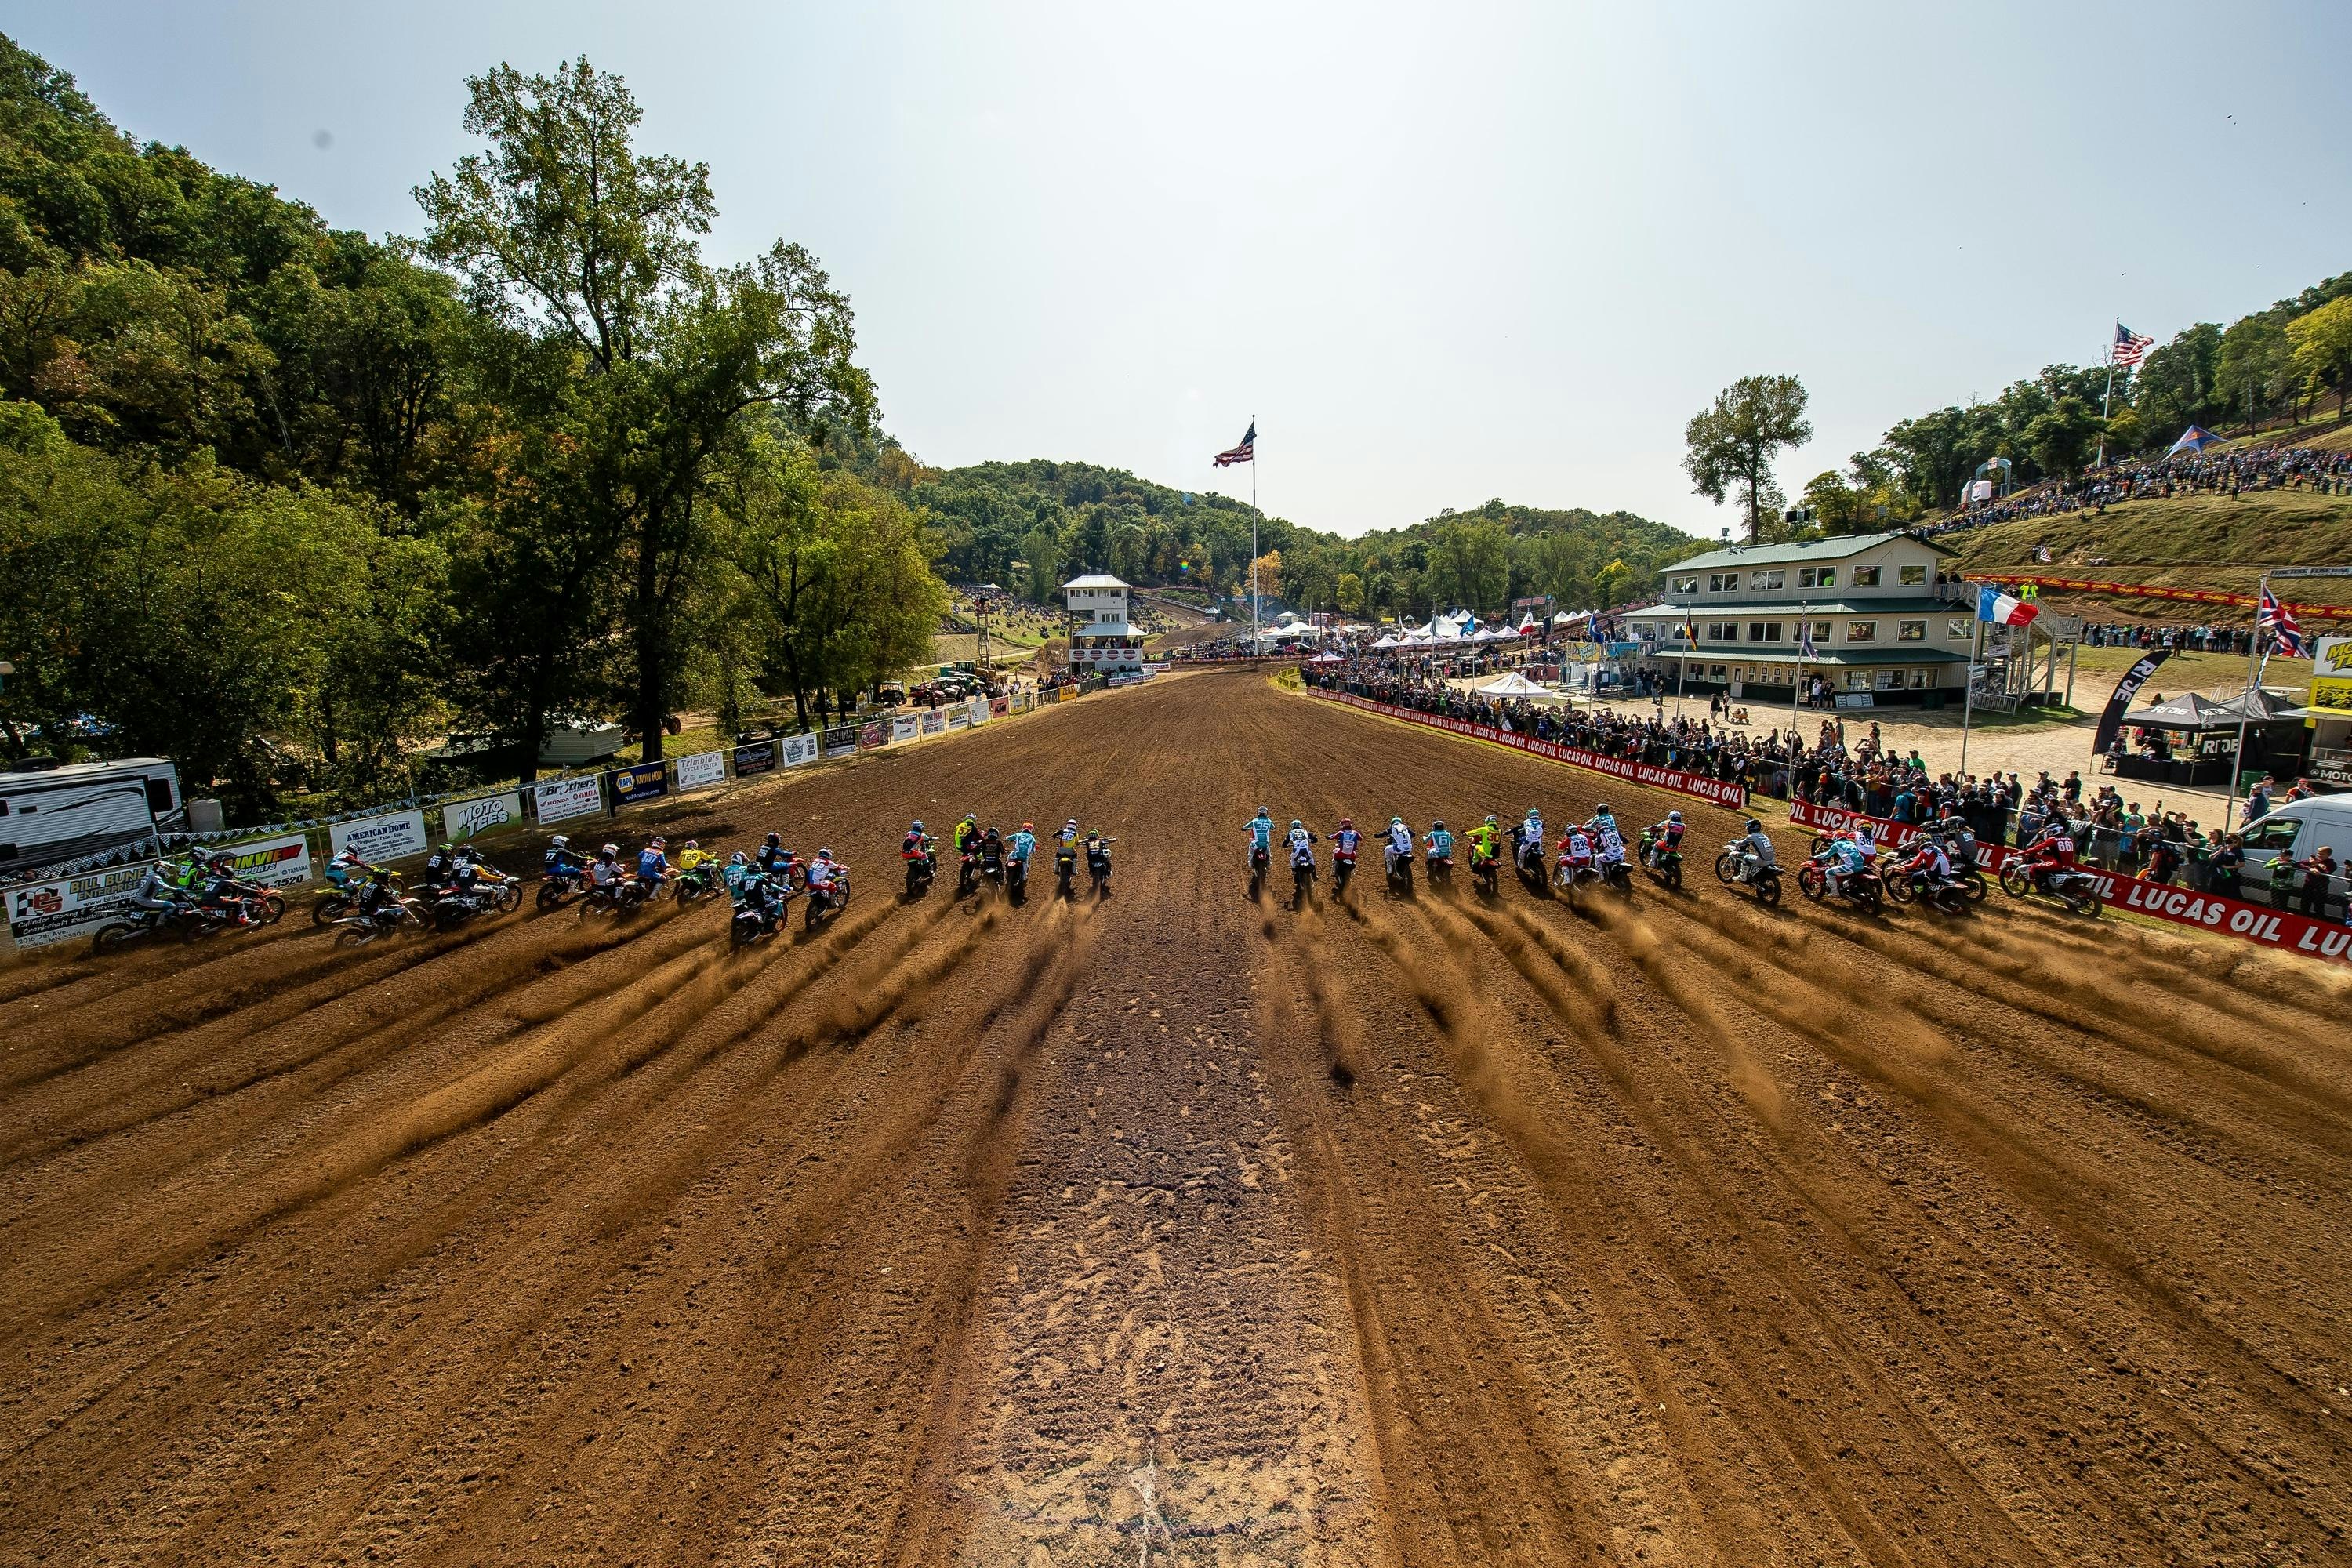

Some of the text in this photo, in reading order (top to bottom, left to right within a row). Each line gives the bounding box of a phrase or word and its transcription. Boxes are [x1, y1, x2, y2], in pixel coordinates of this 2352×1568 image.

[994, 703, 1006, 713] KTM
[1378, 704, 1388, 713] LUCAS
[1394, 708, 1405, 718] LUCAS
[1411, 712, 1422, 721] LUCAS
[1429, 717, 1442, 727] LUCAS
[1450, 720, 1464, 732] LUCAS
[1474, 726, 1489, 738] LUCAS
[1499, 731, 1526, 748] LUCAS OIL
[1527, 739, 1556, 757] LUCAS OIL
[1559, 747, 1592, 766] LUCAS OIL
[1595, 756, 1633, 777] LUCAS OIL
[619, 776, 633, 788] NAPA
[636, 770, 663, 785] KNOW HOW
[1637, 766, 1682, 789] LUCAS OIL
[625, 789, 659, 800] NAPAonline.com
[1687, 778, 1739, 803] LUCAS OIL
[459, 800, 504, 829] MOTO
[466, 809, 510, 838] TEES
[1256, 822, 1269, 831] 35
[347, 822, 411, 841] AMERICAN HOME
[958, 826, 971, 836] 57
[1062, 832, 1073, 840] 26
[1439, 835, 1448, 846] 6
[1487, 832, 1501, 844] 30
[545, 852, 556, 861] 77
[681, 853, 696, 862] 726
[288, 865, 309, 874] YAMAHA
[70, 868, 147, 894] BILL BUNE
[745, 880, 757, 891] 68
[78, 881, 140, 901] ENTERPRISE
[1975, 847, 1993, 868] IL
[2127, 884, 2226, 926] LUCAS
[2230, 909, 2282, 942] OIL
[83, 891, 138, 906] www.billbune.co
[53, 911, 78, 920] Boring
